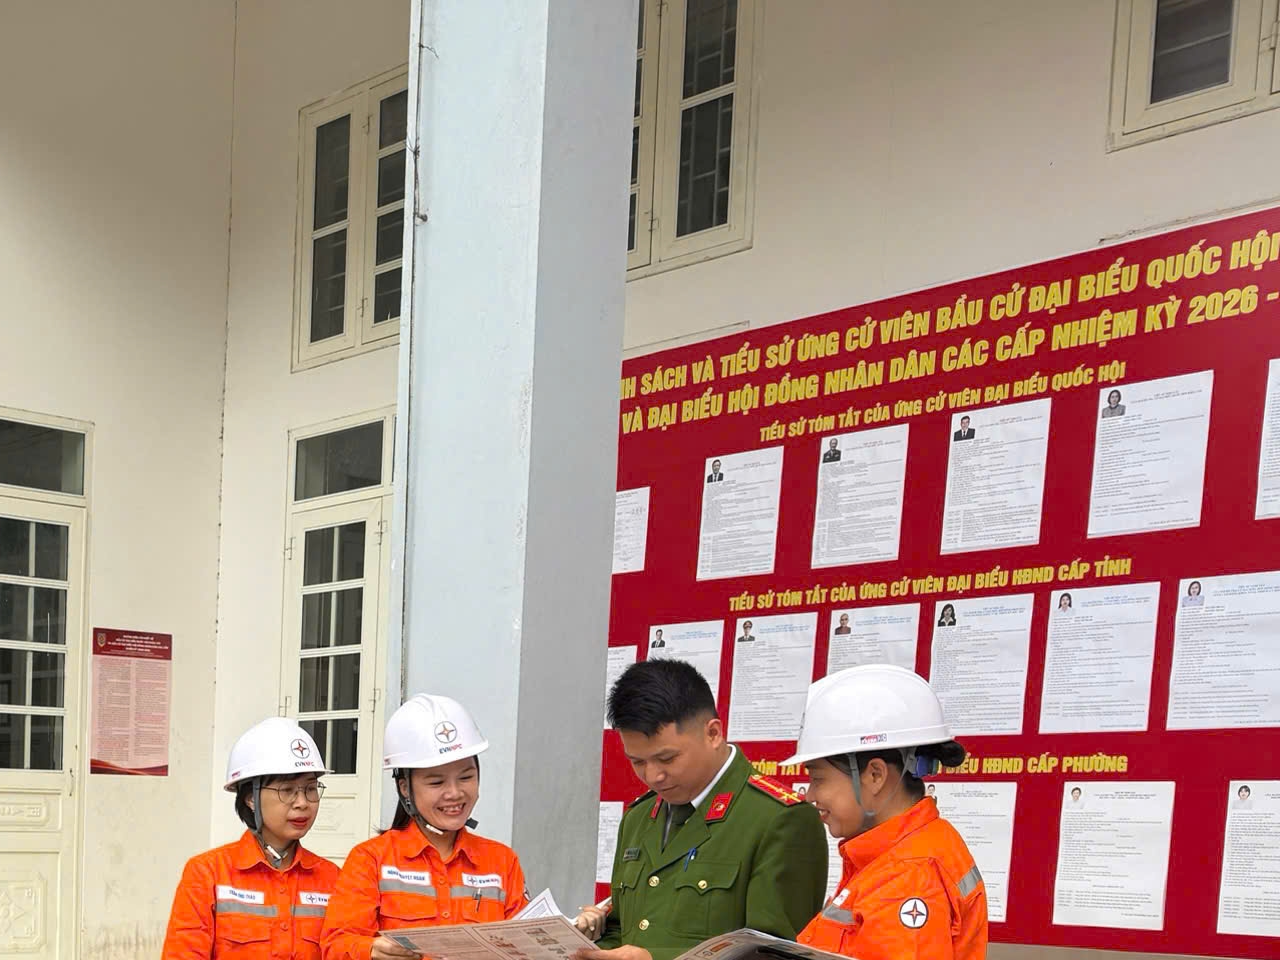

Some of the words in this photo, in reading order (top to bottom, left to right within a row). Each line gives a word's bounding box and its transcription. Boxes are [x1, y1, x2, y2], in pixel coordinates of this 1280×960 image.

[640, 366, 687, 396] SÁCH
[692, 355, 715, 385] VÀ
[720, 342, 761, 378] TIỂU
[765, 335, 795, 369] SỬ
[797, 332, 839, 361] ỨNG
[845, 316, 877, 352] CỬ
[880, 310, 930, 345] VIÊN
[936, 294, 984, 333] BẦU
[989, 282, 1027, 321] CỬ
[1028, 279, 1072, 315] ĐẠI
[1078, 256, 1140, 303] BIỂU
[1146, 238, 1222, 290] QUỐC
[1229, 229, 1280, 271] HỘI
[622, 405, 643, 435] VÀ
[647, 402, 677, 431] ĐẠI
[681, 386, 724, 424] BIỂU
[727, 383, 760, 416] HỘI
[764, 371, 820, 408] ĐỒNG
[824, 360, 884, 396] NHÂN
[889, 349, 937, 383] DÂN
[942, 337, 989, 372] CÁC
[995, 321, 1046, 362] CẤP
[1051, 308, 1138, 351] NHIỆM
[1144, 294, 1182, 334] KỲ
[1187, 285, 1259, 325] 2026
[760, 419, 786, 443] TIỂU
[788, 416, 807, 438] SỬ
[808, 414, 835, 434] TÓM
[838, 405, 861, 428] TẮT
[864, 402, 890, 424] CỦA
[894, 399, 922, 419] ỨNG
[926, 390, 947, 413] CỬ
[948, 387, 982, 409] VIÊN
[984, 383, 1010, 405] ĐẠI
[1013, 371, 1049, 398] BIỂU
[1051, 363, 1095, 393] QUỐC
[1097, 359, 1127, 384] HỘI
[729, 590, 754, 612] TIỂU
[757, 589, 776, 609] SỬ
[776, 587, 803, 608] TÓM
[805, 583, 829, 605] TẮT
[830, 581, 856, 604] CỦA
[859, 580, 888, 600] ỨNG
[890, 576, 911, 598] CỬ
[912, 574, 944, 594] VIÊN
[947, 573, 972, 594] ĐẠI
[974, 565, 1010, 589] BIỂU
[1057, 557, 1090, 581] CẤP
[1094, 554, 1133, 578] TỈNH
[1027, 752, 1059, 774] CẤP
[1062, 752, 1129, 773] PHƯỜNG
